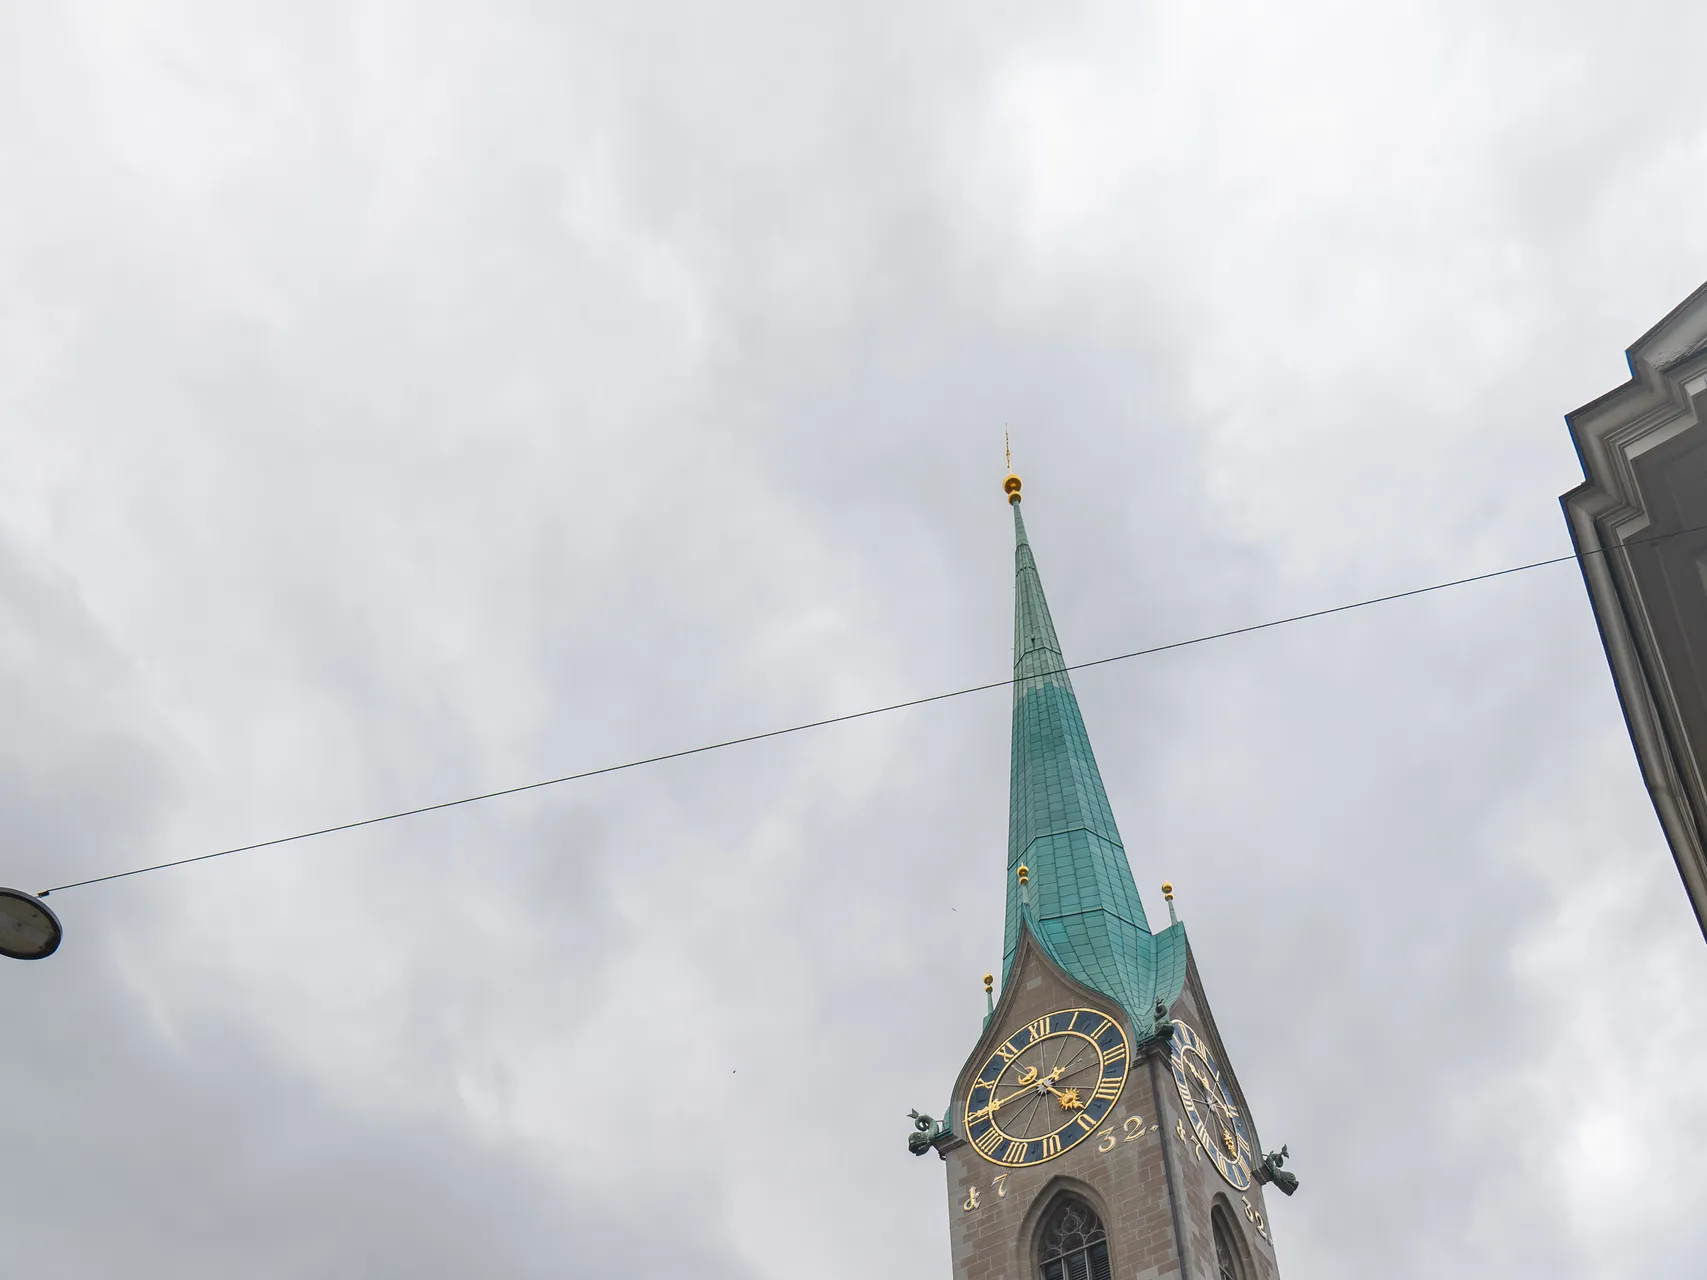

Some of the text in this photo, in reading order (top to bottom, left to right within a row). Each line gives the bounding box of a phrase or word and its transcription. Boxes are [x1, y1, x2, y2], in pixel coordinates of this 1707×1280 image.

[1028, 1017, 1051, 1042] XII
[1090, 1019, 1113, 1040] II
[997, 1041, 1019, 1063] XI
[1103, 1043, 1126, 1065] III
